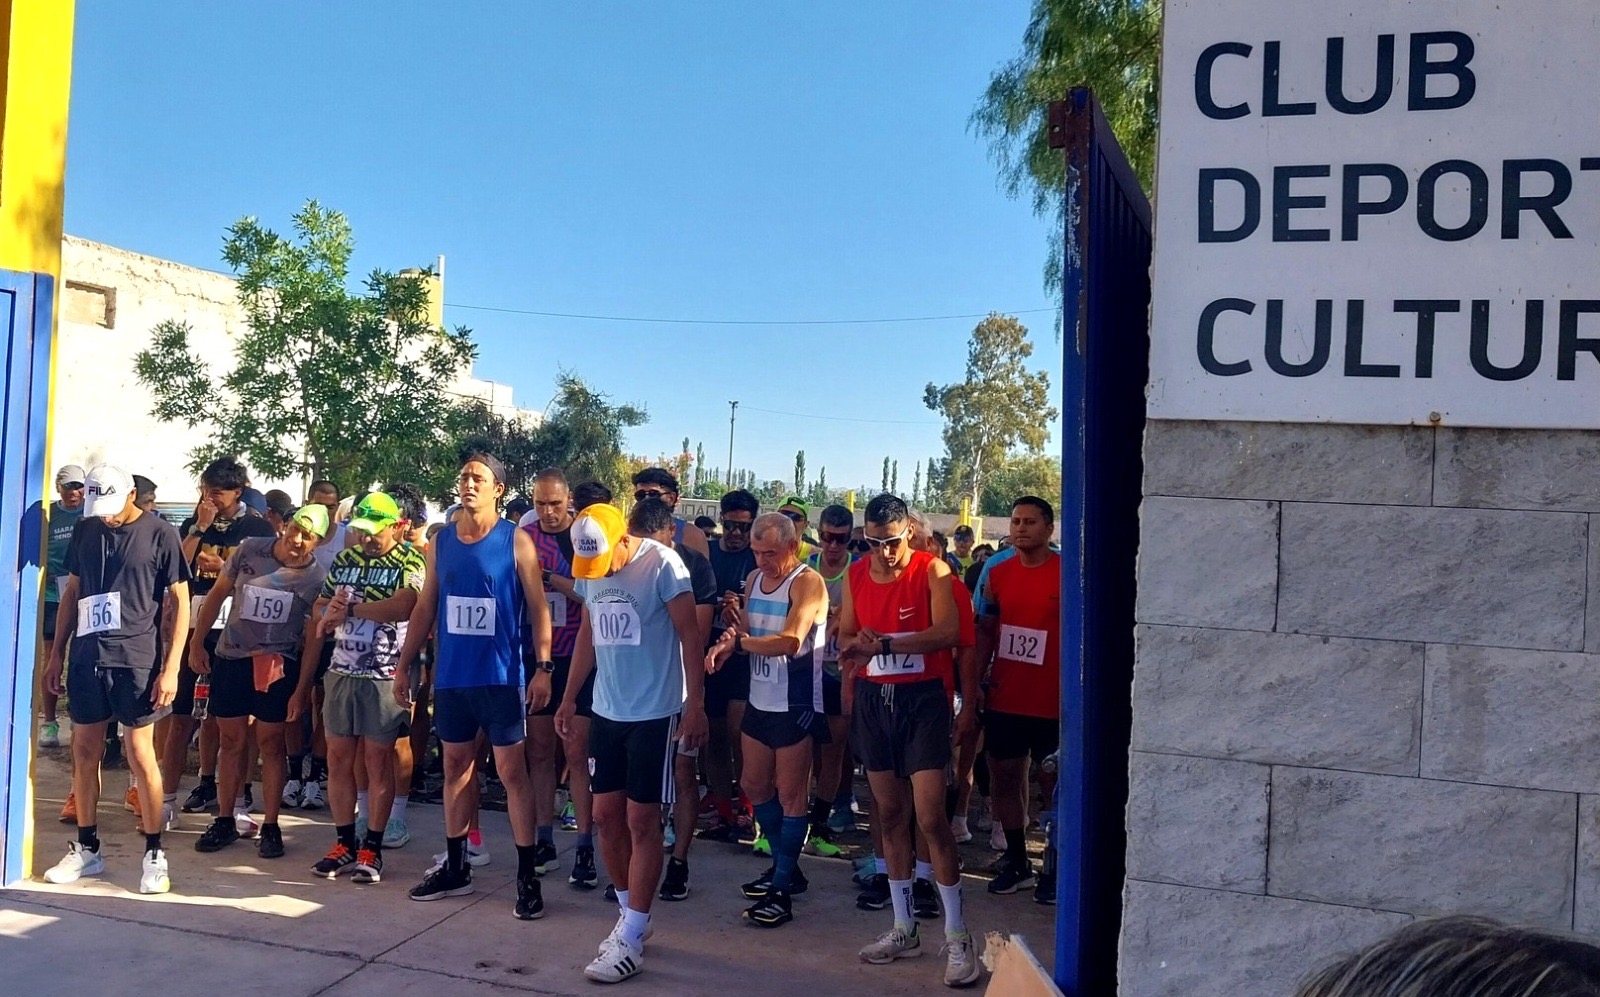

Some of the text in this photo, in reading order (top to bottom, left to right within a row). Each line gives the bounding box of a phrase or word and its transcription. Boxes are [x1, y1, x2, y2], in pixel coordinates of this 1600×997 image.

[1193, 30, 1477, 120] CLUB
[1196, 297, 1600, 381] CULTUR
[88, 485, 116, 496] FILA
[578, 544, 598, 552] JUAN
[334, 567, 361, 583] SAN
[86, 601, 112, 629] 156
[252, 596, 284, 620] 159
[456, 604, 487, 630] 112
[599, 612, 633, 640] 002
[1007, 633, 1039, 659] 132
[751, 653, 771, 678] 06
